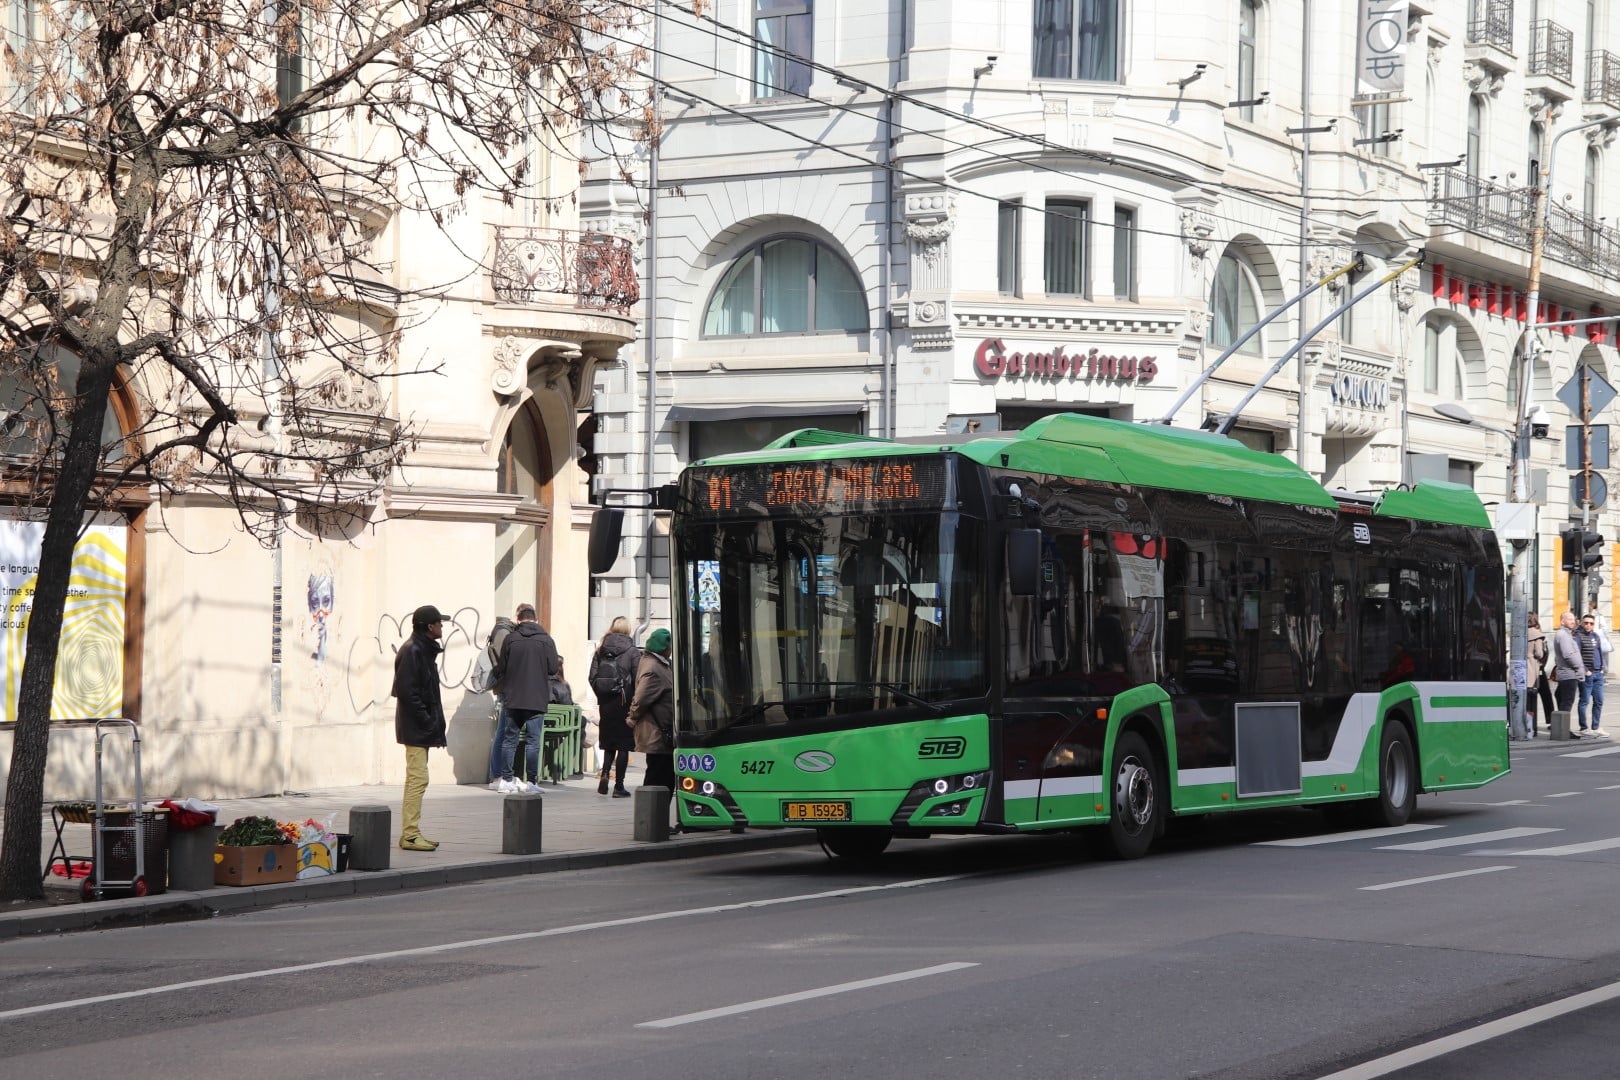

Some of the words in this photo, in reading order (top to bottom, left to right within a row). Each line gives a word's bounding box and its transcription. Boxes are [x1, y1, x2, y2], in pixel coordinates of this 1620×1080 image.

[974, 338, 1158, 379] Gambrinus
[772, 470, 825, 490] FOSTA
[832, 466, 873, 487] LINIE
[882, 465, 912, 484] 336
[766, 488, 838, 505] COMPLEX
[8, 564, 39, 575] langua
[2, 586, 22, 596] time
[10, 603, 32, 612] coffe
[918, 738, 962, 756] STB
[740, 760, 774, 775] 5427
[799, 804, 807, 817] B
[812, 804, 844, 817] 15925
